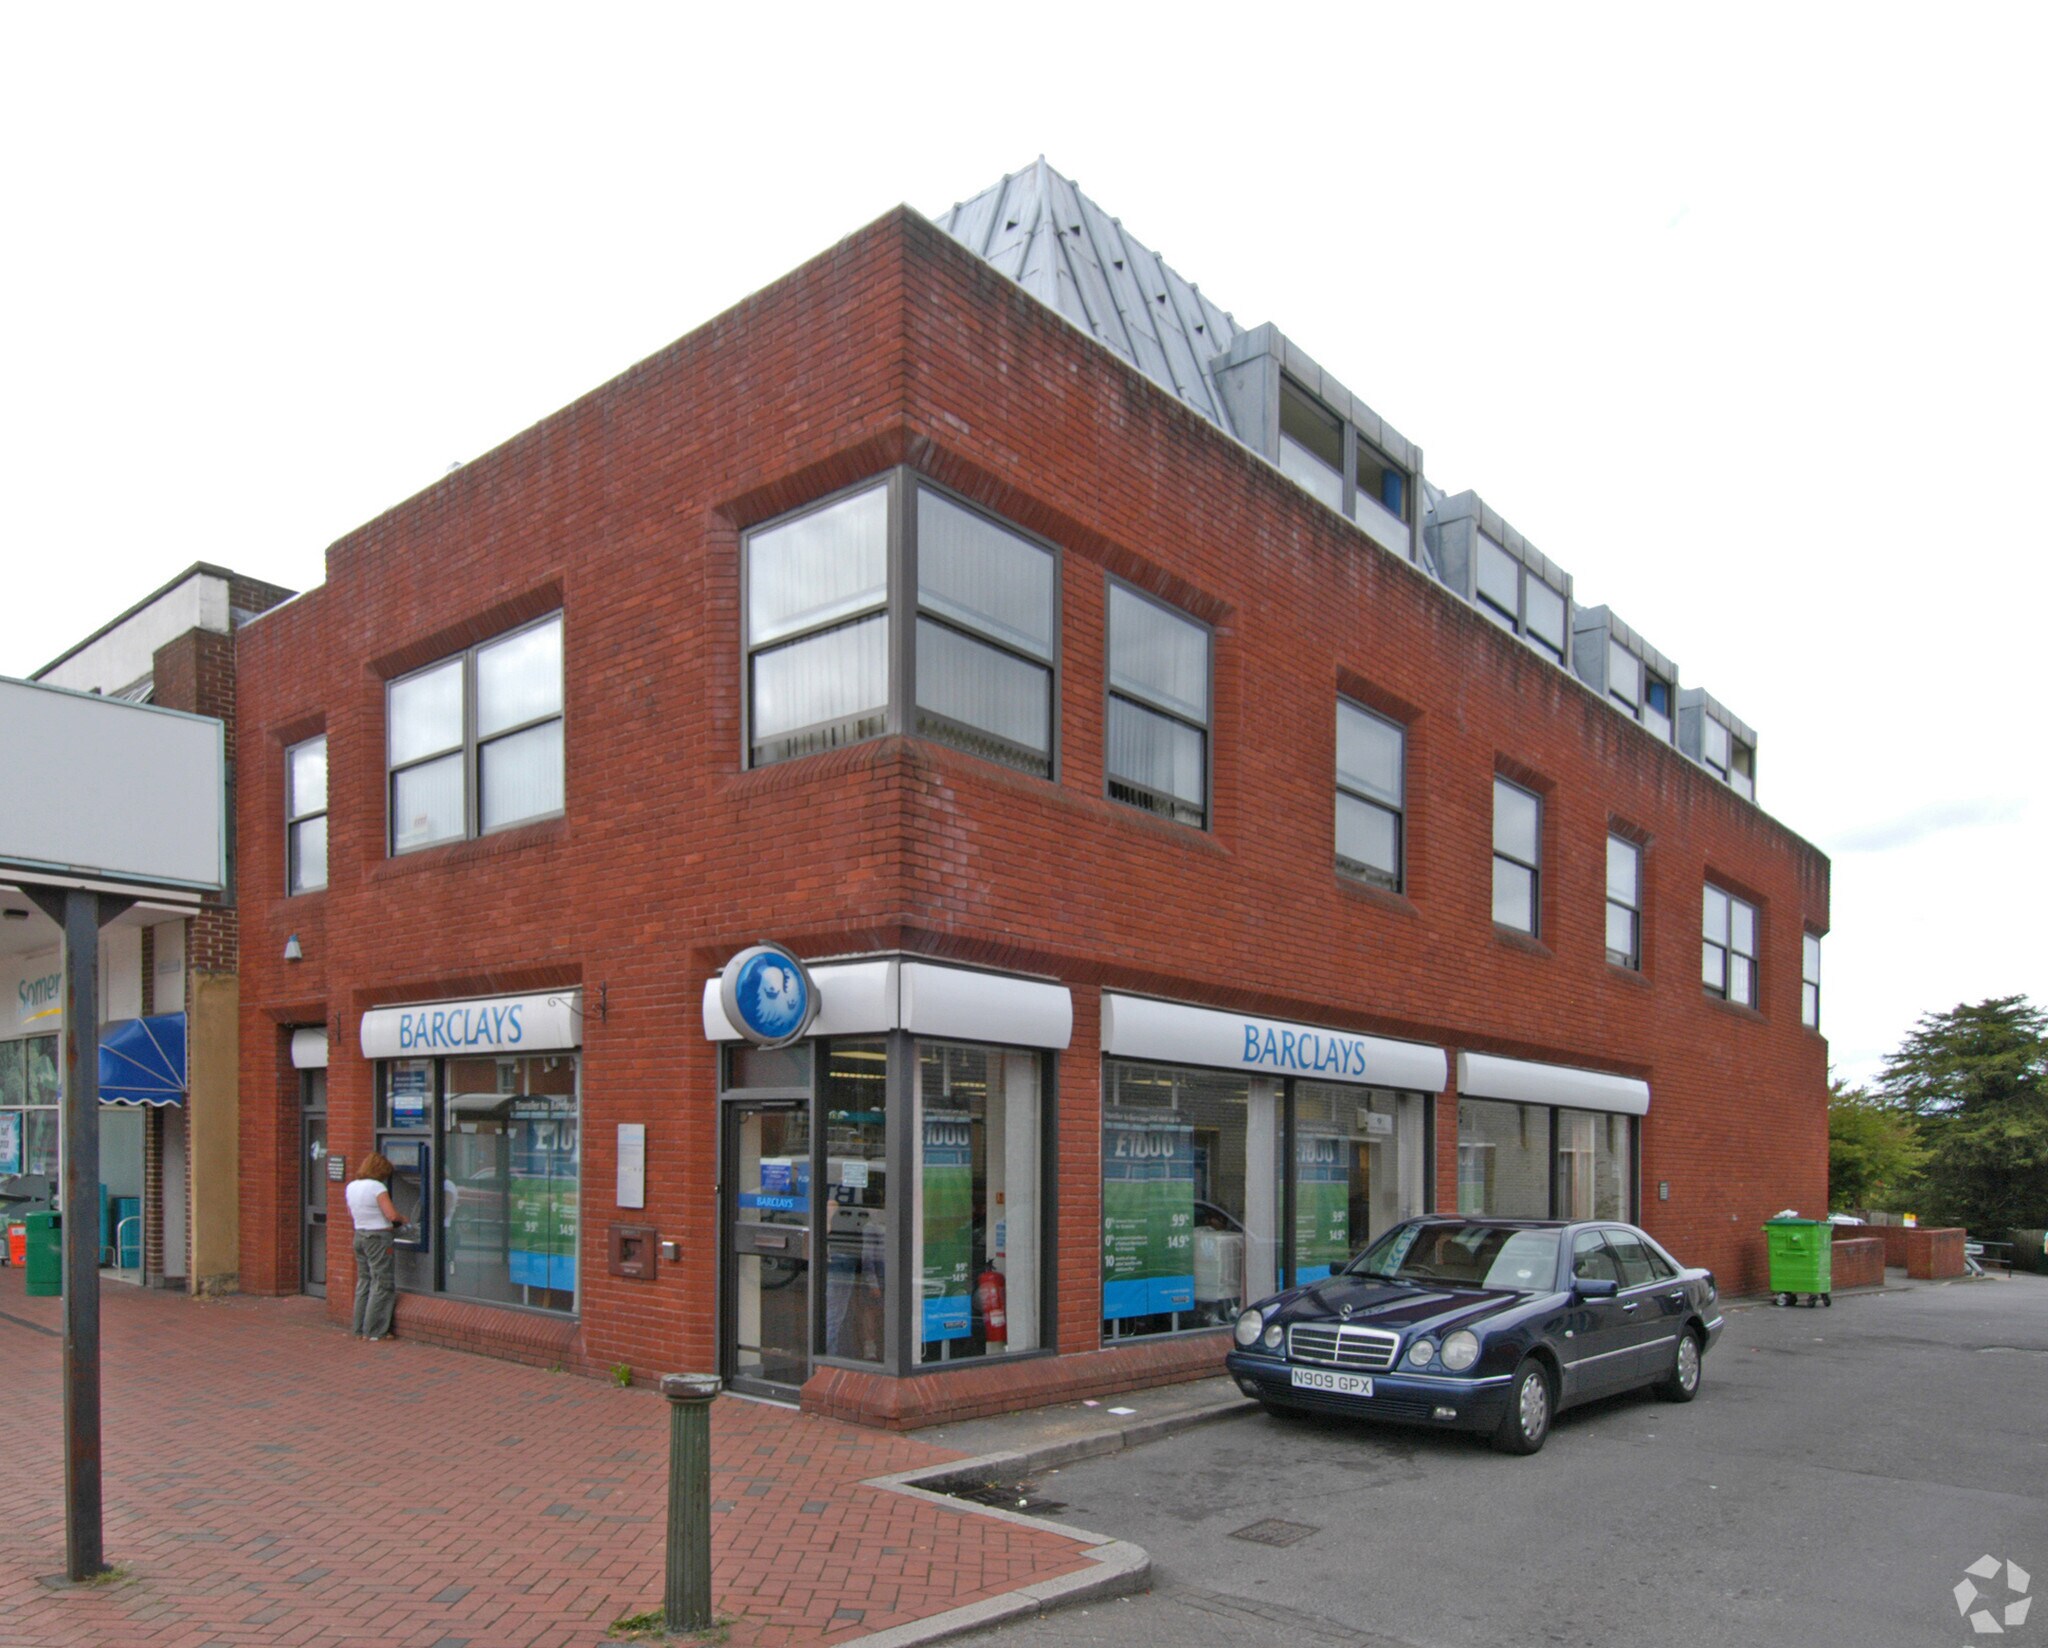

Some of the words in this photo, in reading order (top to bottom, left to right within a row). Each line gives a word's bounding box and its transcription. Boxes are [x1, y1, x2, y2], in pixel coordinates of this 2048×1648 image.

[18, 972, 61, 1006] Somer
[400, 1003, 523, 1049] BARCLAYS
[1242, 1024, 1366, 1076] BARCLAYS
[756, 1196, 794, 1209] BARCLAYS
[1294, 1370, 1334, 1389] N909
[1338, 1376, 1370, 1394] GPX
